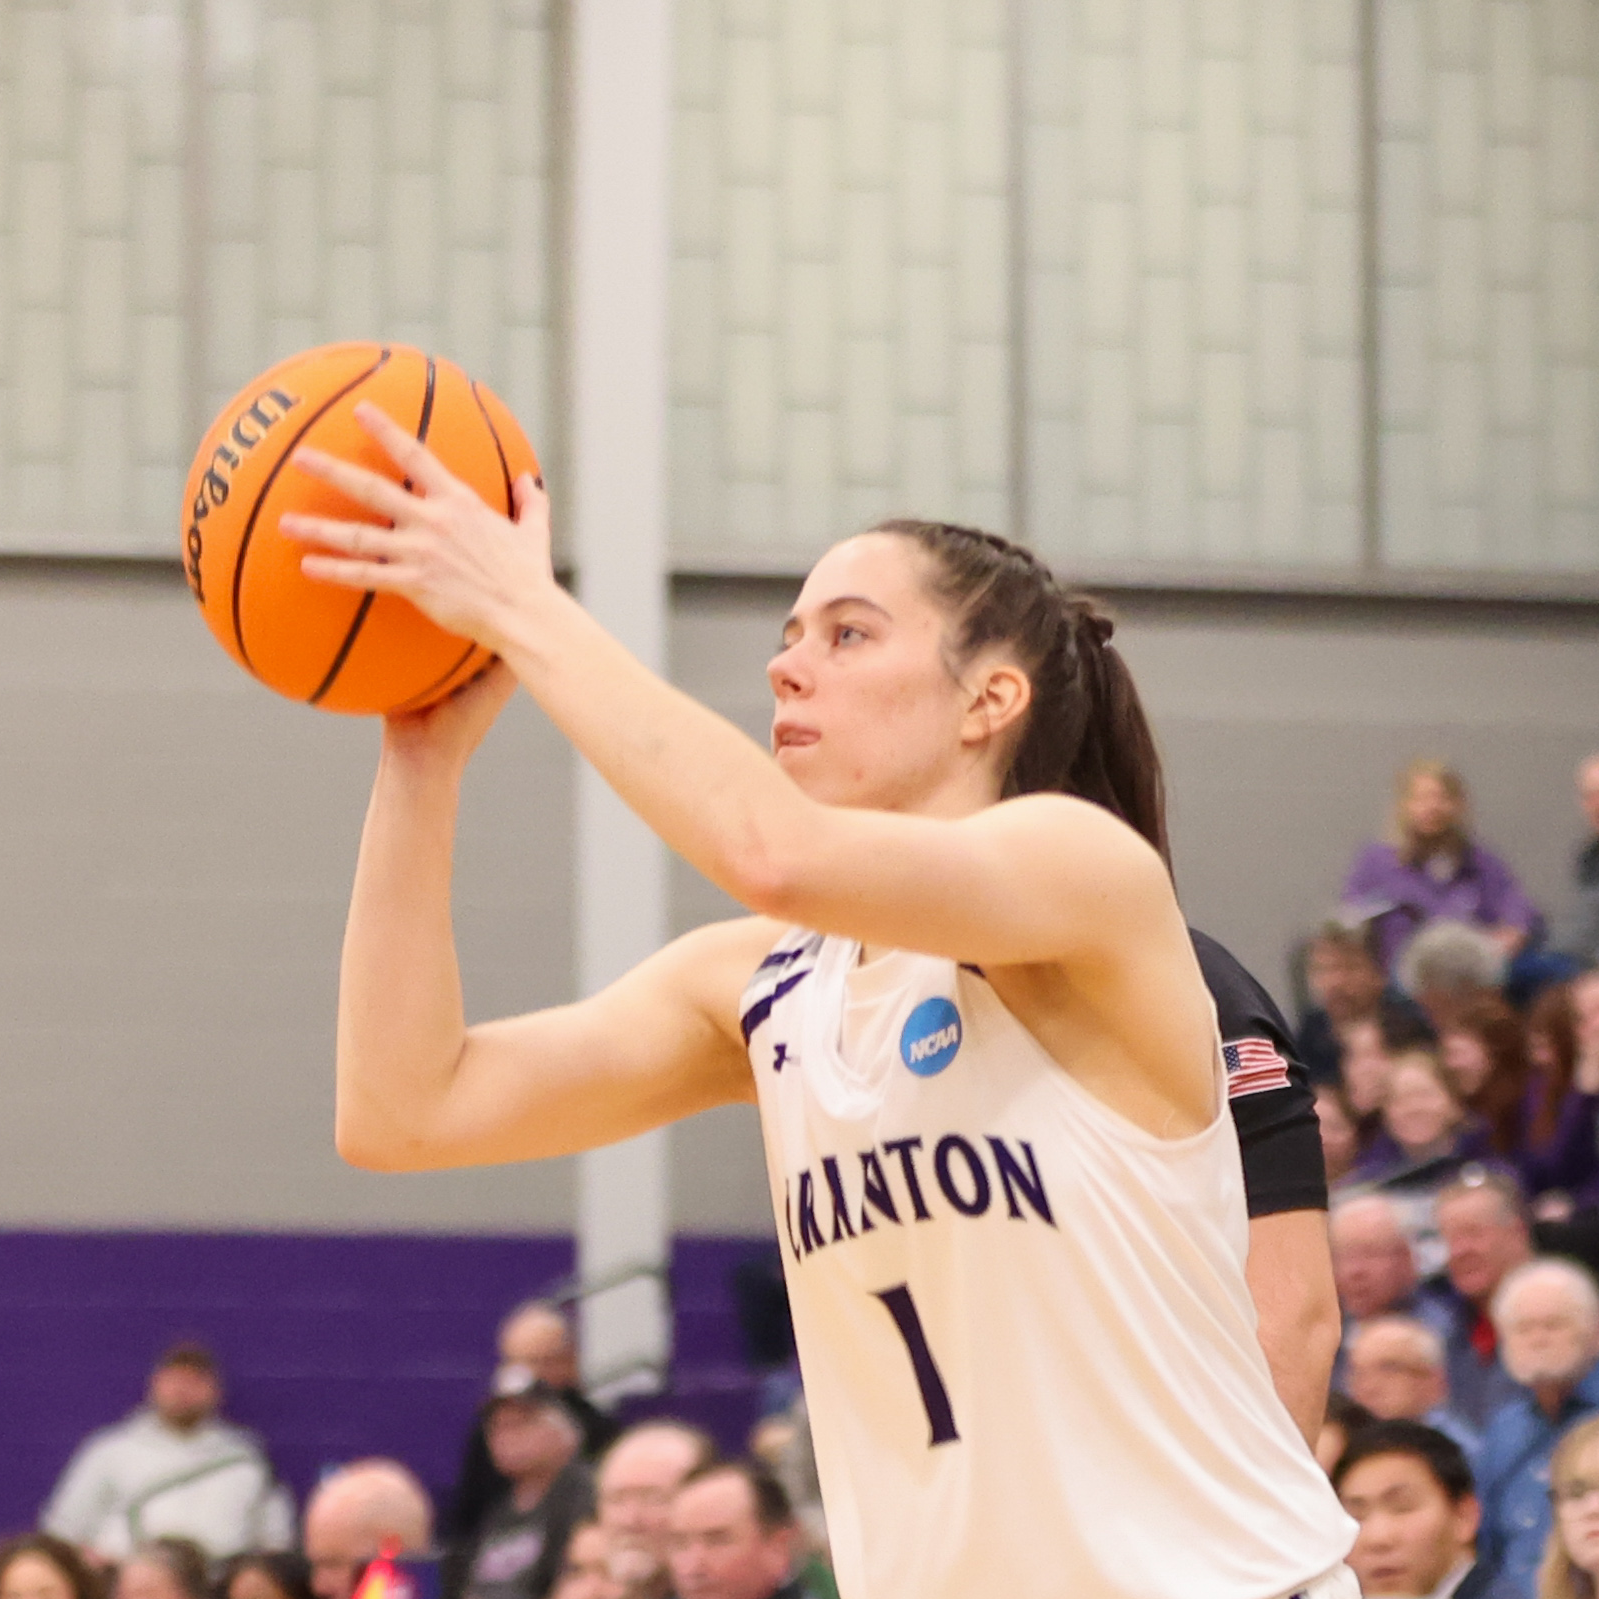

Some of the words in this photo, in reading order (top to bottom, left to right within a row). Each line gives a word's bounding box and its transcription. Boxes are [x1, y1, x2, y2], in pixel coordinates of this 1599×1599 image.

[187, 387, 299, 606] Wilson
[908, 1022, 958, 1064] NCAA
[785, 1133, 1060, 1265] RANTON
[868, 1280, 961, 1450] 1
